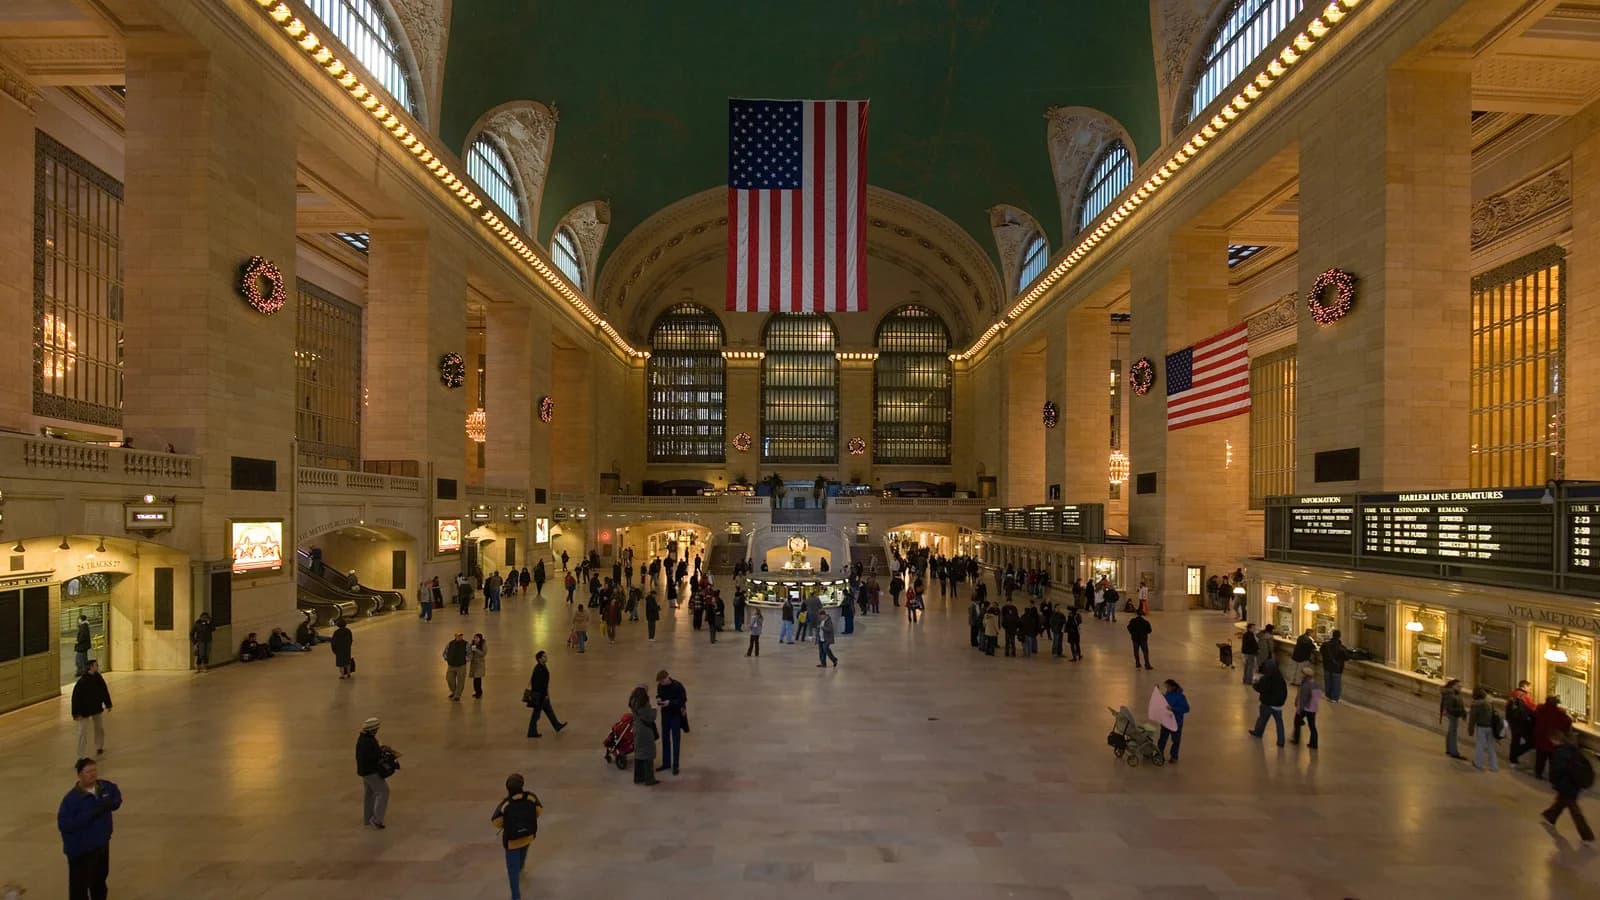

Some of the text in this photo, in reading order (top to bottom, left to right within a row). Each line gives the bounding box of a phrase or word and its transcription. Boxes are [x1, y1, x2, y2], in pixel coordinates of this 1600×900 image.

[1399, 494, 1430, 502] HARLEM
[1451, 490, 1504, 500] DEPARTURES
[86, 561, 112, 569] TRACKS
[1508, 604, 1534, 619] MTA
